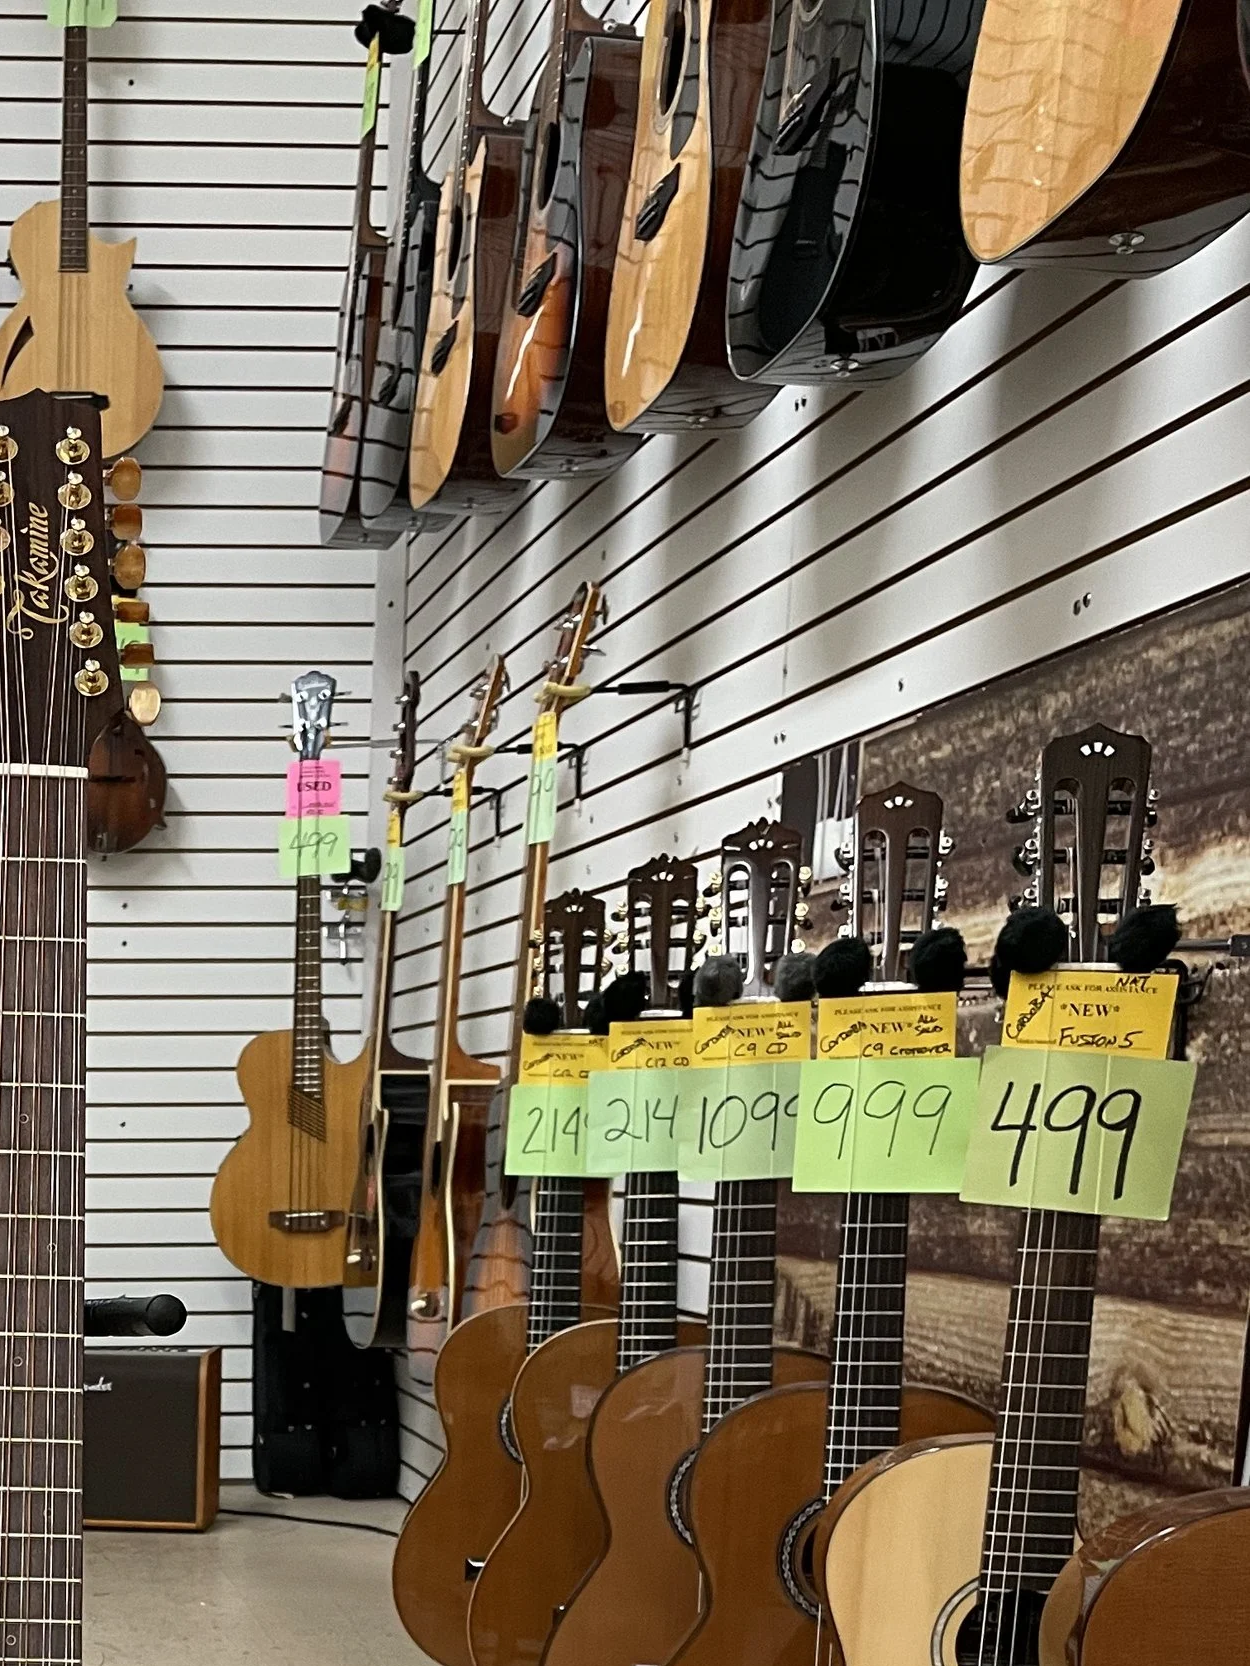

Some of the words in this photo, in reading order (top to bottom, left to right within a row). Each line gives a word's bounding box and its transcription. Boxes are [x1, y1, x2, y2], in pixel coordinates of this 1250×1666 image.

[6, 501, 69, 640] Takamine
[297, 781, 332, 792] USED
[289, 832, 338, 858] 499
[1116, 975, 1151, 993] NAT
[734, 1043, 756, 1056] C9
[1118, 1031, 1142, 1048] 5
[522, 1106, 588, 1156] 214
[814, 1080, 951, 1160] 999
[990, 1081, 1143, 1200] 499
